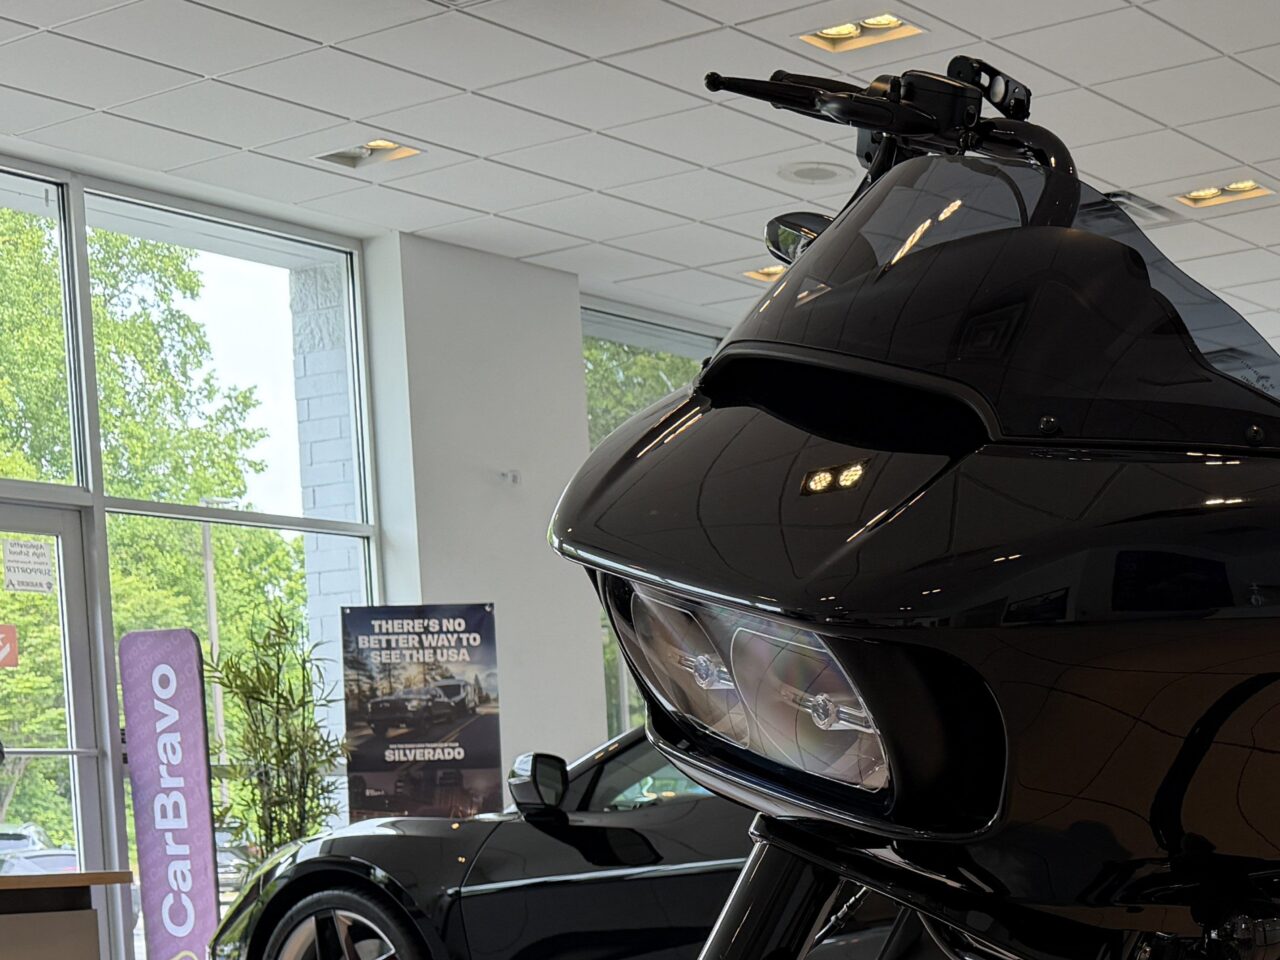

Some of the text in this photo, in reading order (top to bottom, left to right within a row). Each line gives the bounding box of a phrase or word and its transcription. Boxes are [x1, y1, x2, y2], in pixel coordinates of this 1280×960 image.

[371, 618, 466, 633] THERE'S NO
[358, 632, 481, 649] BETTER WAY TO
[370, 647, 470, 663] SEE THE USA
[384, 747, 465, 762] SILVERADO
[151, 663, 195, 938] CarBravo
